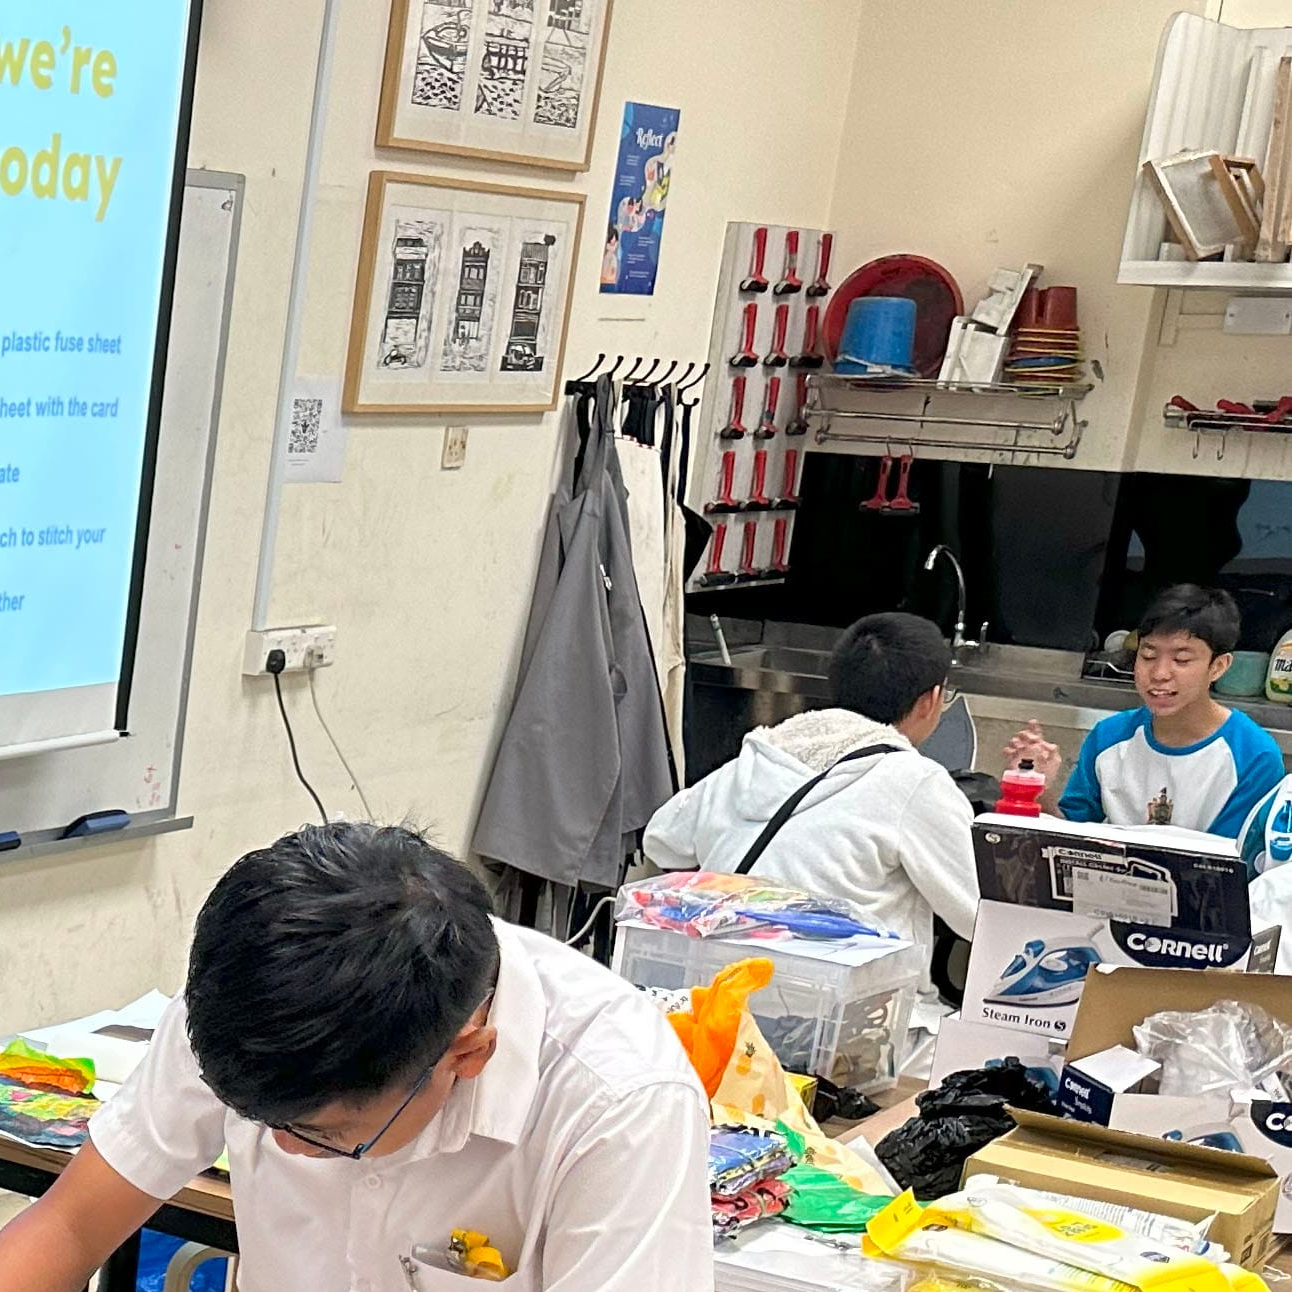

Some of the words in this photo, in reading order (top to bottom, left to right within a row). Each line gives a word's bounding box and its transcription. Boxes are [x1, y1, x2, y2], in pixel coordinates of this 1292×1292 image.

[1, 330, 51, 357] plastic
[53, 330, 84, 353] fuse
[86, 332, 122, 355] sheet
[35, 396, 65, 418] with
[67, 396, 88, 418] the
[90, 397, 120, 419] card
[20, 527, 35, 547] to
[37, 525, 74, 547] stitch
[75, 526, 107, 549] your
[981, 1005, 1021, 1025] Steam
[1024, 1014, 1051, 1029] Iron
